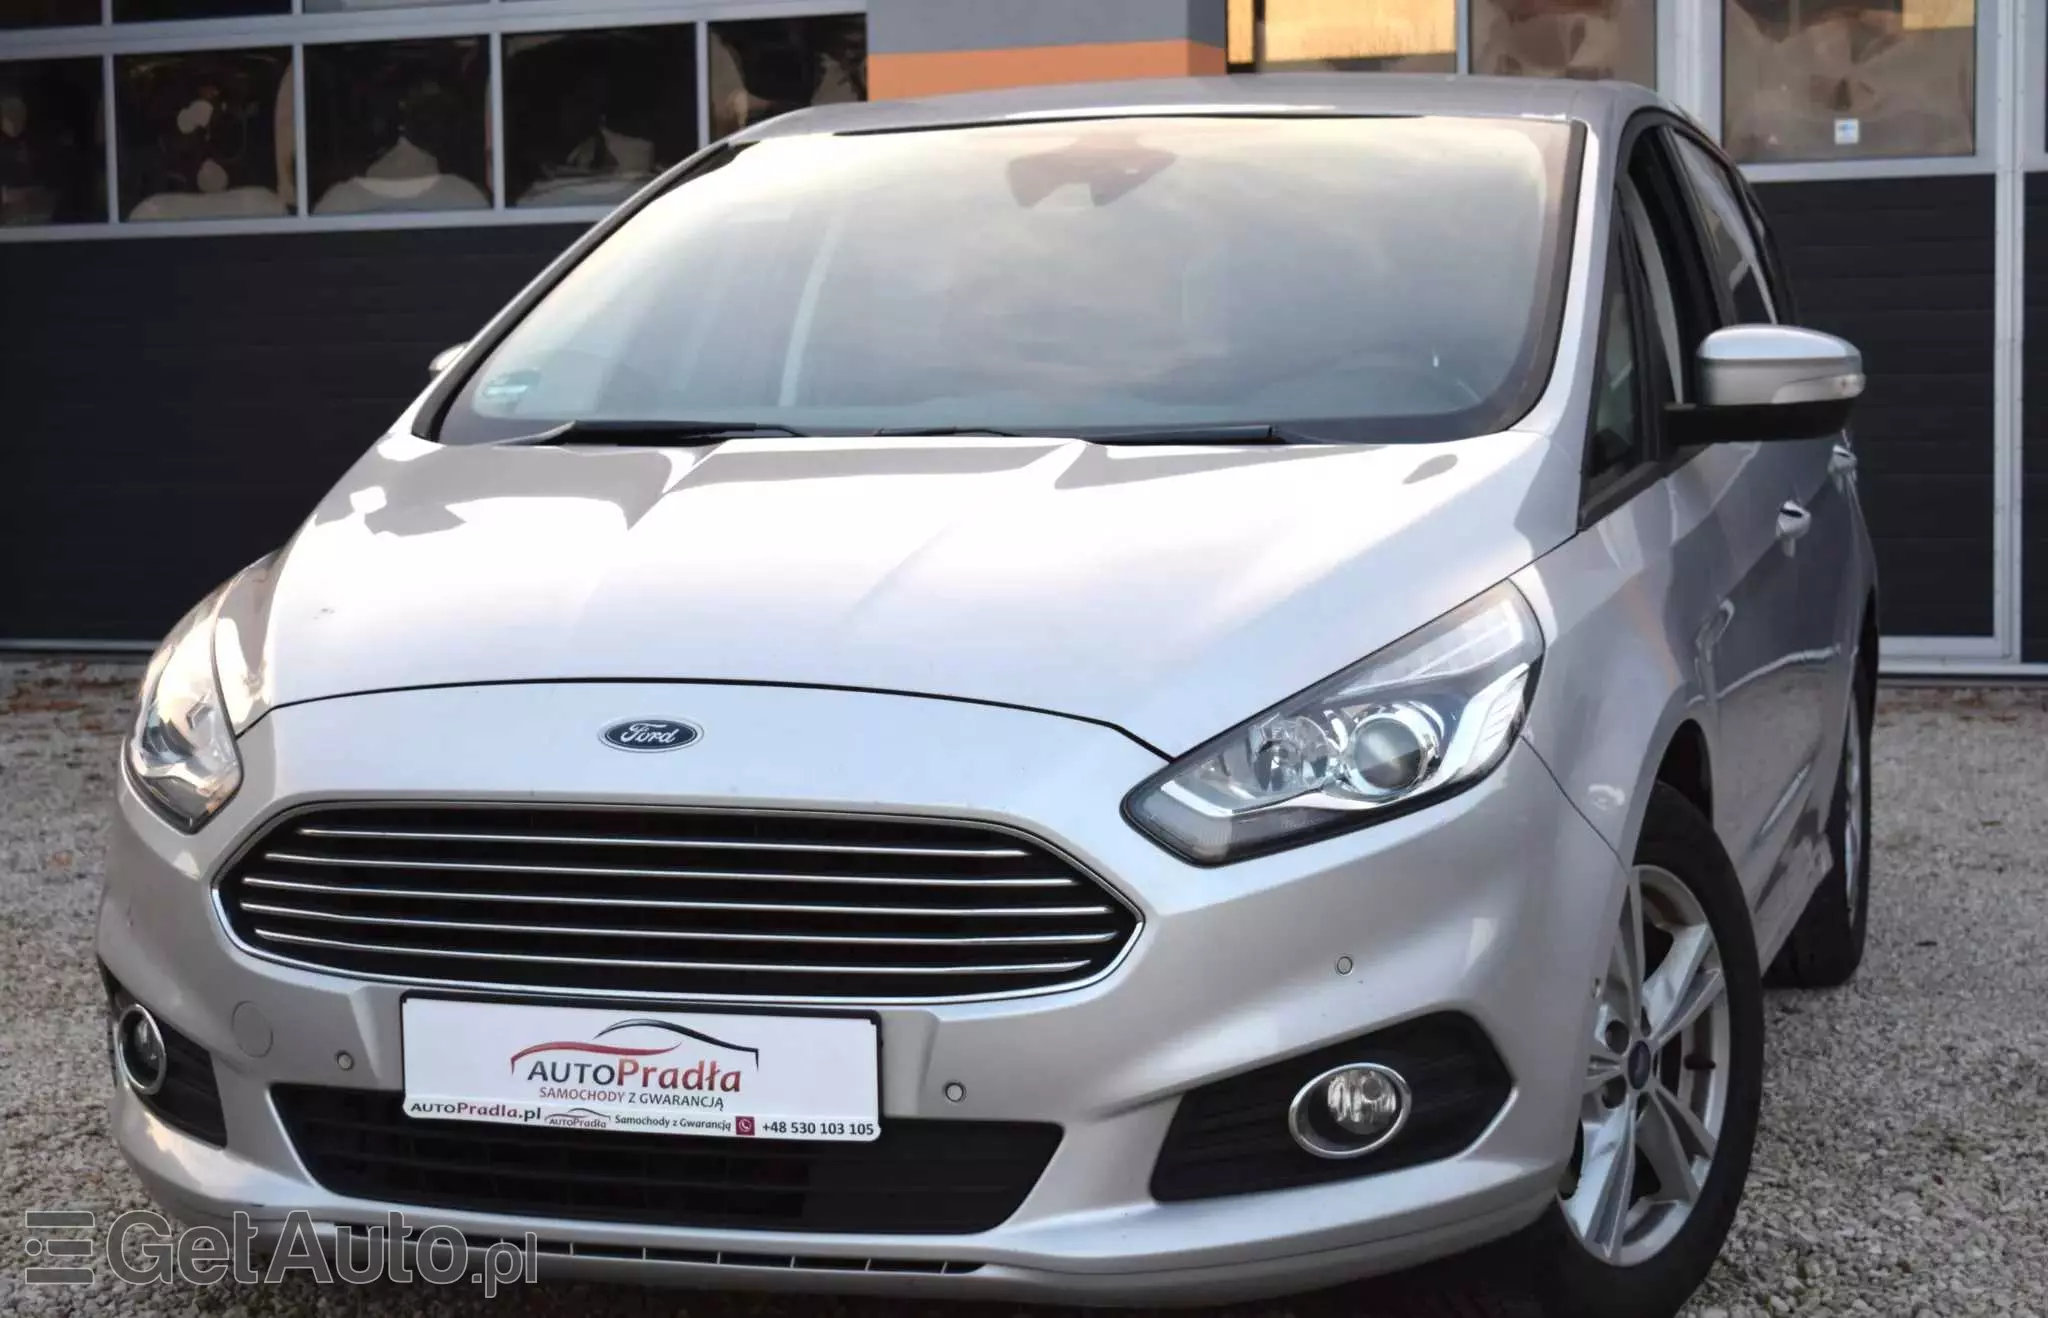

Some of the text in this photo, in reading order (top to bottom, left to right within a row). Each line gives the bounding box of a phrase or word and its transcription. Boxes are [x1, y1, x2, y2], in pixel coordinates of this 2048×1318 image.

[620, 722, 680, 743] Ford
[527, 1058, 742, 1093] AUTOPradła
[539, 1086, 724, 1111] SAMOCHODY Z GWARANCJĄ
[615, 1114, 732, 1132] Samochody z Gwarancją
[762, 1121, 874, 1136] +48 530 103 105
